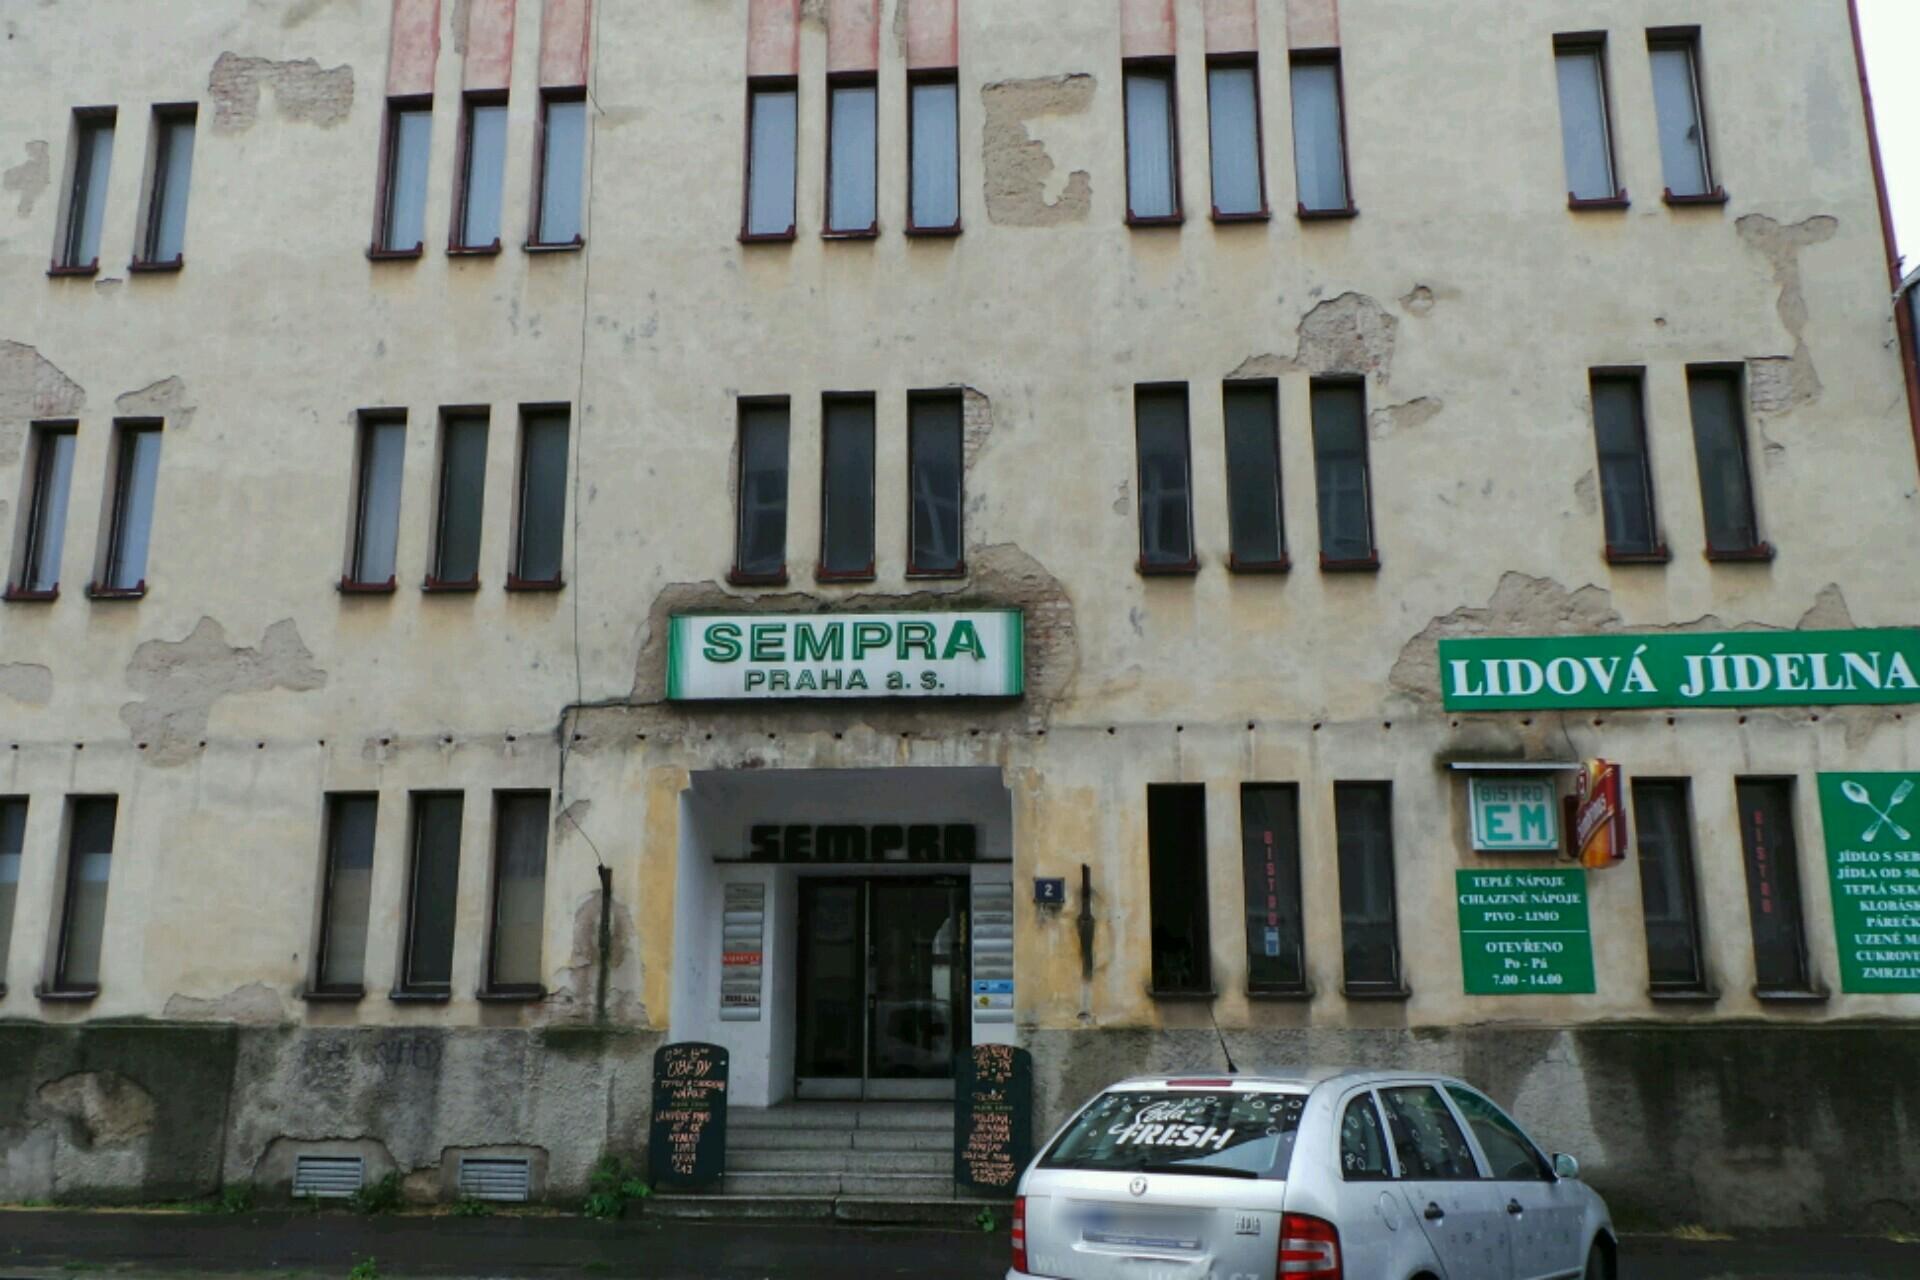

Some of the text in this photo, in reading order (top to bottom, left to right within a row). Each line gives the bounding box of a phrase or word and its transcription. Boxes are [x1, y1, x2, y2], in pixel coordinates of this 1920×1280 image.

[702, 619, 987, 662] SEMPRA
[1448, 642, 1920, 697] LIDOVÁ JÍDELNA
[743, 668, 869, 692] PRAHA
[1481, 784, 1543, 801] BISTRO
[750, 824, 977, 861] SEMPRA
[1838, 849, 1880, 863] JÍDLO
[1882, 851, 1892, 862] S
[1837, 865, 1877, 879] JÍDLA
[1880, 868, 1902, 878] OD
[1472, 873, 1565, 887] TEPLÉ NÁPOJE
[1044, 884, 1053, 897] 2
[1842, 881, 1887, 895] TEPLÁ
[1460, 890, 1581, 905] CHLAZENÉ NÁPOJE
[1483, 912, 1515, 922] PIVO
[1525, 912, 1560, 921] LIMO
[1854, 930, 1901, 945] UZENÉ
[1485, 938, 1564, 953] OTEVŘENO
[1504, 958, 1521, 969] Po
[1492, 974, 1518, 985] 7.00
[1530, 974, 1563, 985] 14.00
[1113, 1123, 1235, 1150] FRESH
